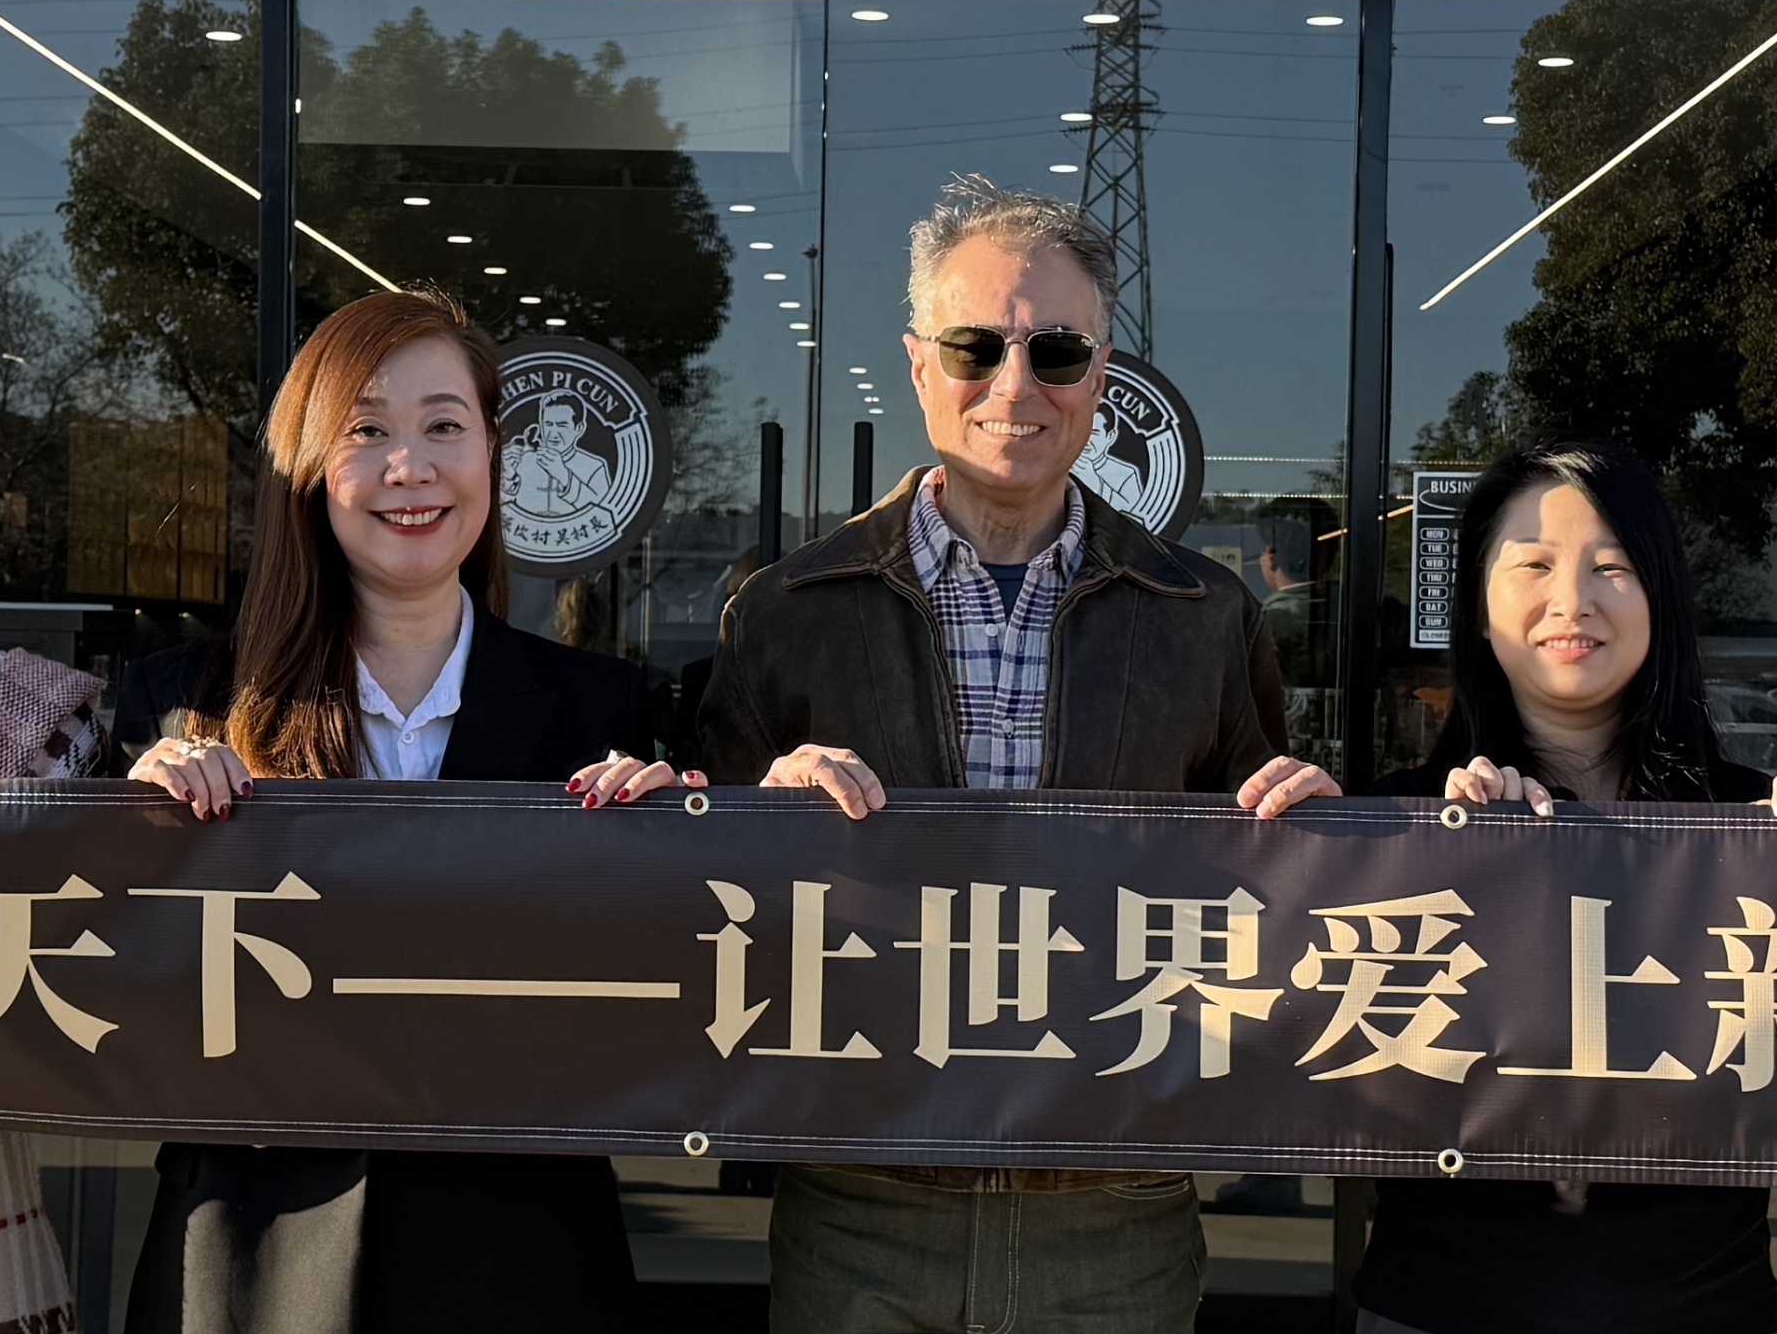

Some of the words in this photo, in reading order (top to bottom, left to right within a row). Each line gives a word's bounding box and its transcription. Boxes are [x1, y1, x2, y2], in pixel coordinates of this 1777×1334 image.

[498, 371, 545, 408] HEN
[552, 371, 572, 389] PI
[576, 377, 619, 414] CUN
[1107, 385, 1151, 422] CUN
[1430, 480, 1477, 494] BUSIN
